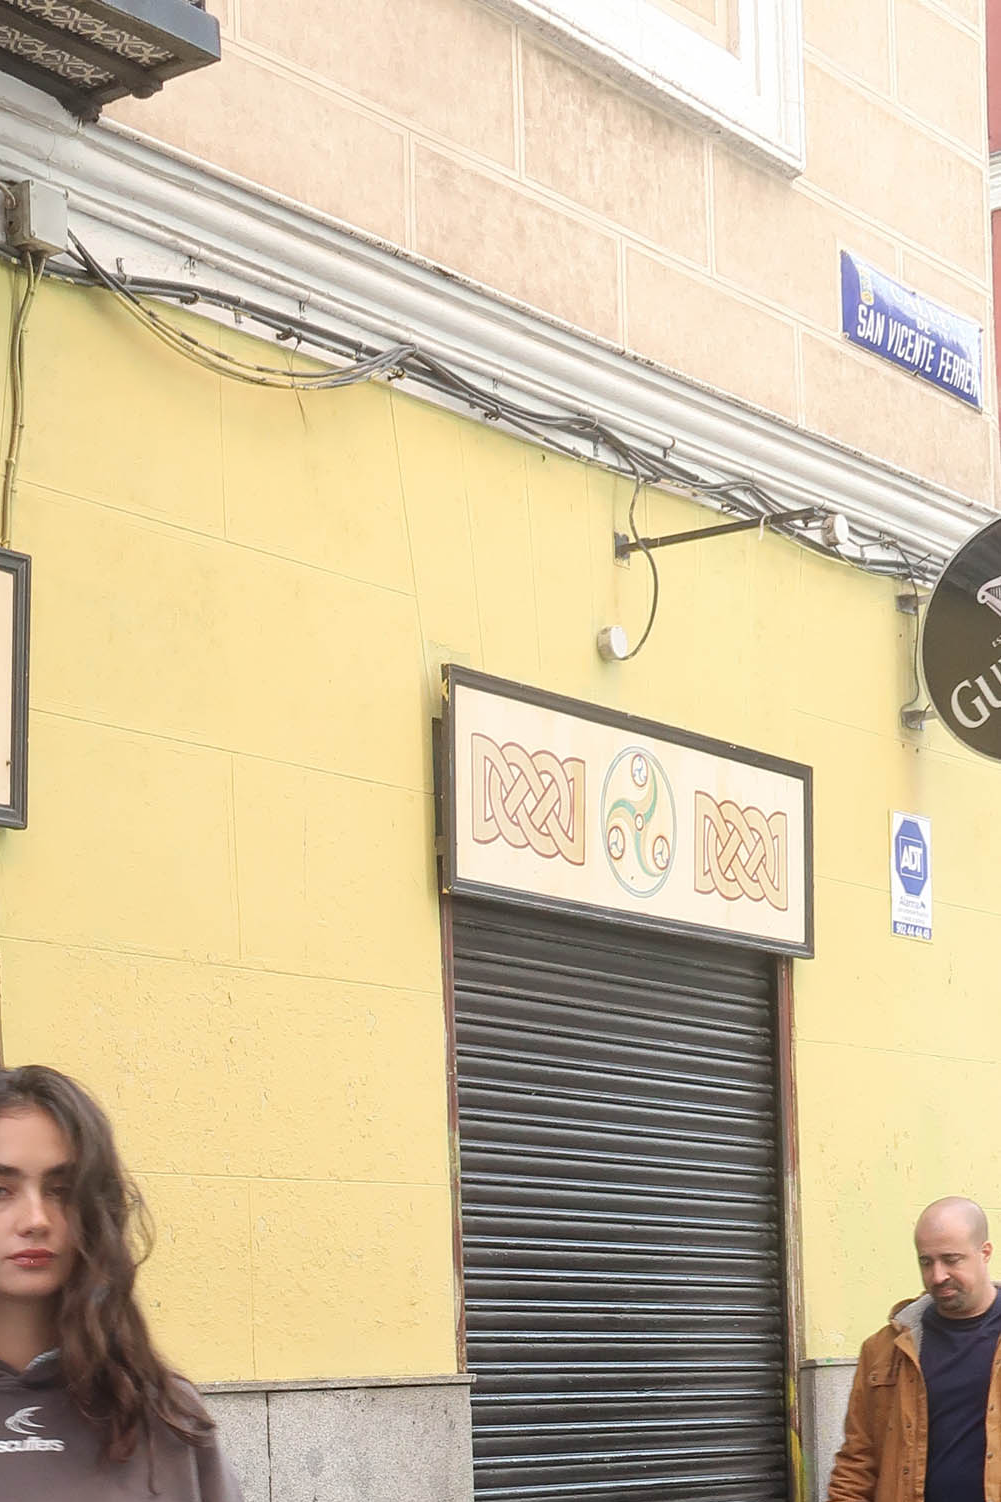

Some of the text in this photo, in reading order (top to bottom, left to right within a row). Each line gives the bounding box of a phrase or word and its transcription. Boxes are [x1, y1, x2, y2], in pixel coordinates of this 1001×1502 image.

[857, 303, 886, 347] SAN
[887, 317, 936, 374] VICENTE
[916, 317, 932, 335] DE
[951, 656, 1001, 728] GU
[901, 844, 923, 873] ADT
